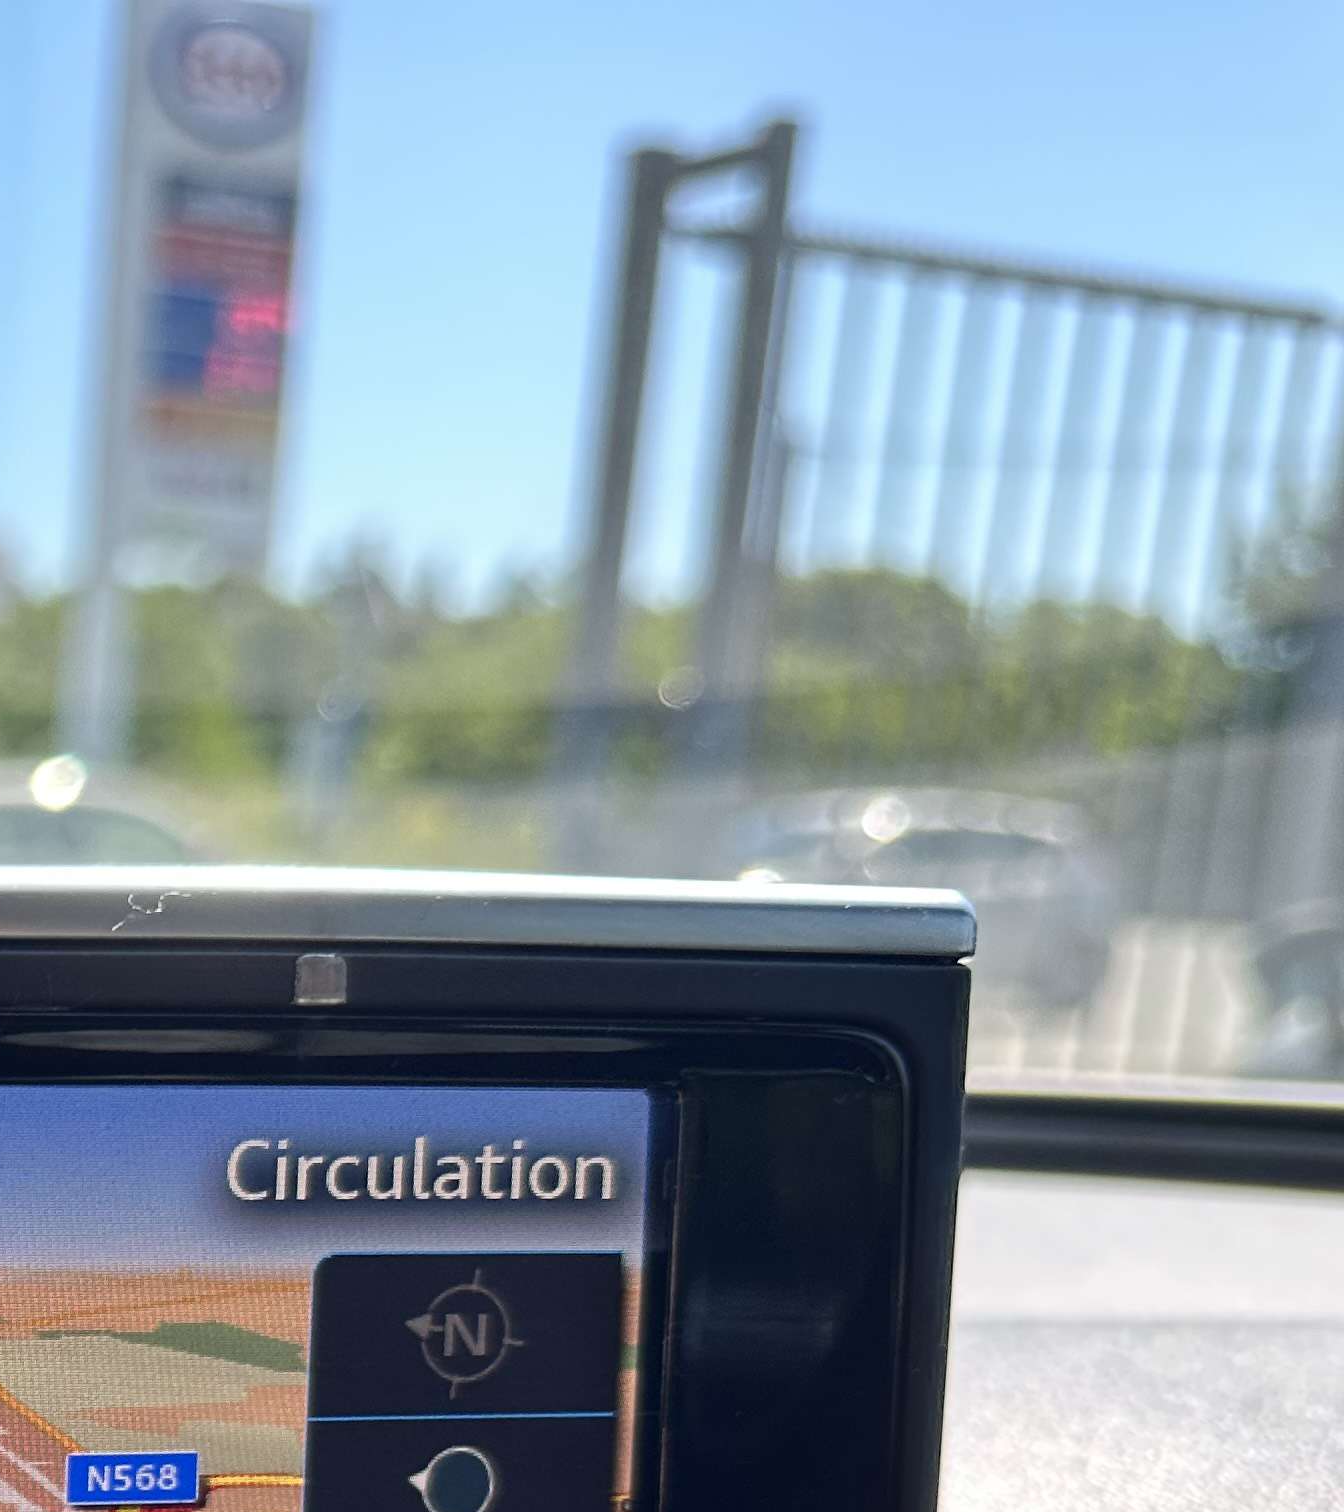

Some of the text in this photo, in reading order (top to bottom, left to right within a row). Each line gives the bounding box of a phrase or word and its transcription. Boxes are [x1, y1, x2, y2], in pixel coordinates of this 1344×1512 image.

[226, 1136, 614, 1202] Circulation
[442, 1313, 488, 1357] N
[86, 1464, 178, 1492] N568
